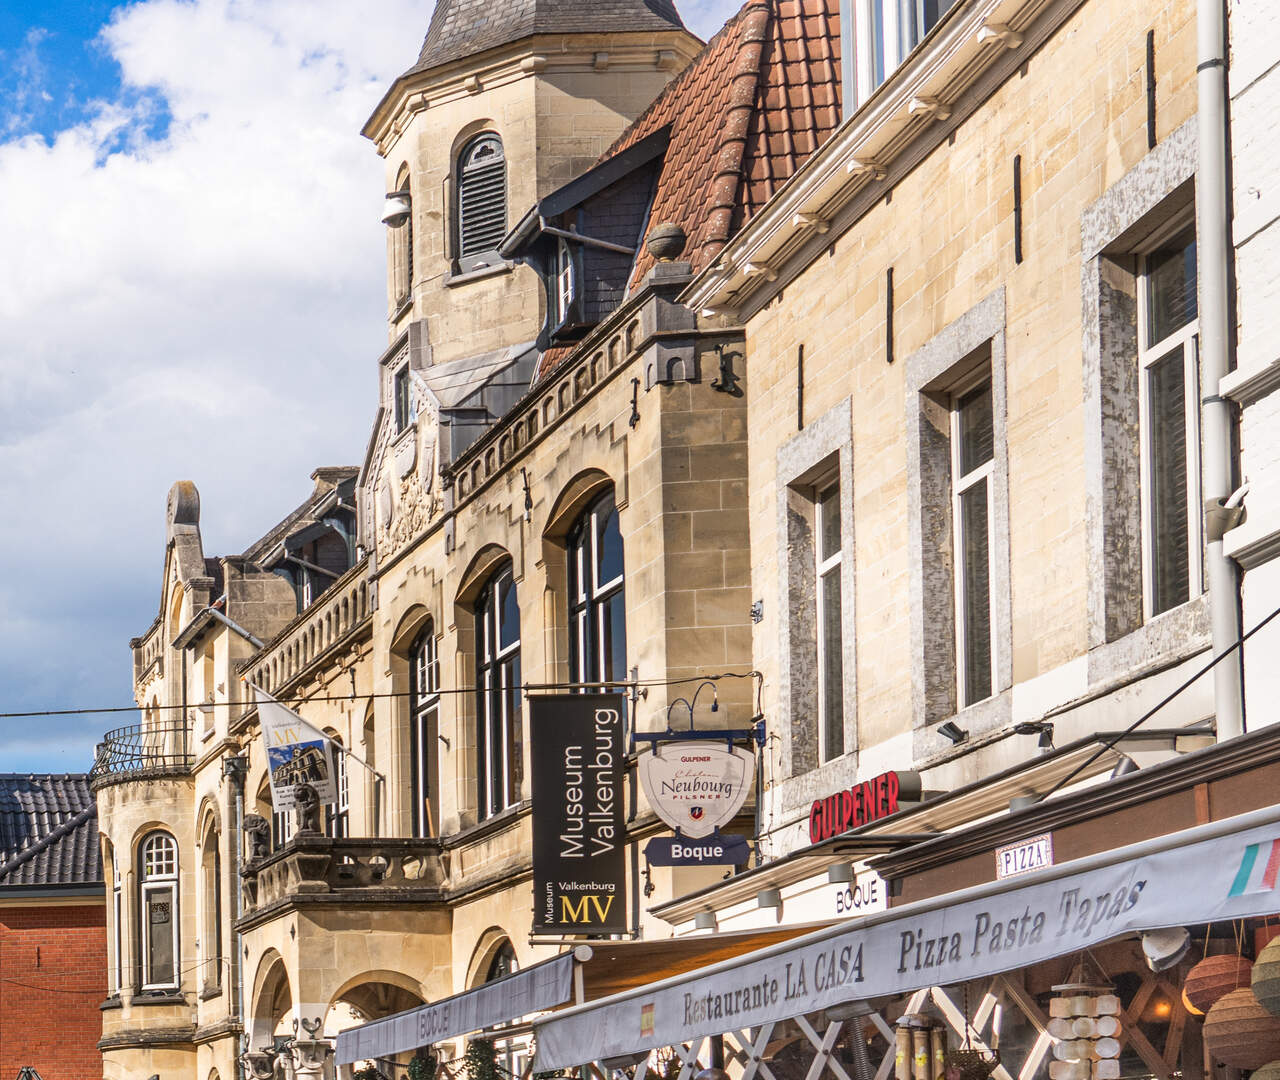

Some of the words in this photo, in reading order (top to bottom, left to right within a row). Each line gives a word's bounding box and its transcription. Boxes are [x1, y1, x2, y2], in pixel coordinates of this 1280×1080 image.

[588, 708, 619, 857] Valkenburg
[661, 777, 732, 799] Neubourg
[560, 746, 584, 858] Museum
[809, 770, 900, 845] GULPENER
[671, 845, 723, 861] Boque
[1004, 843, 1045, 875] PIZZA
[544, 882, 554, 924] Museum
[558, 881, 616, 892] Valkenburg
[836, 879, 878, 914] BOQUE
[559, 895, 615, 923] MV
[683, 974, 779, 1027] Restaurante
[785, 958, 808, 1001] LA
[814, 942, 865, 993] CASA
[897, 928, 962, 974] Pizza
[971, 904, 1046, 958] Pasta
[1056, 880, 1148, 938] Tapas
